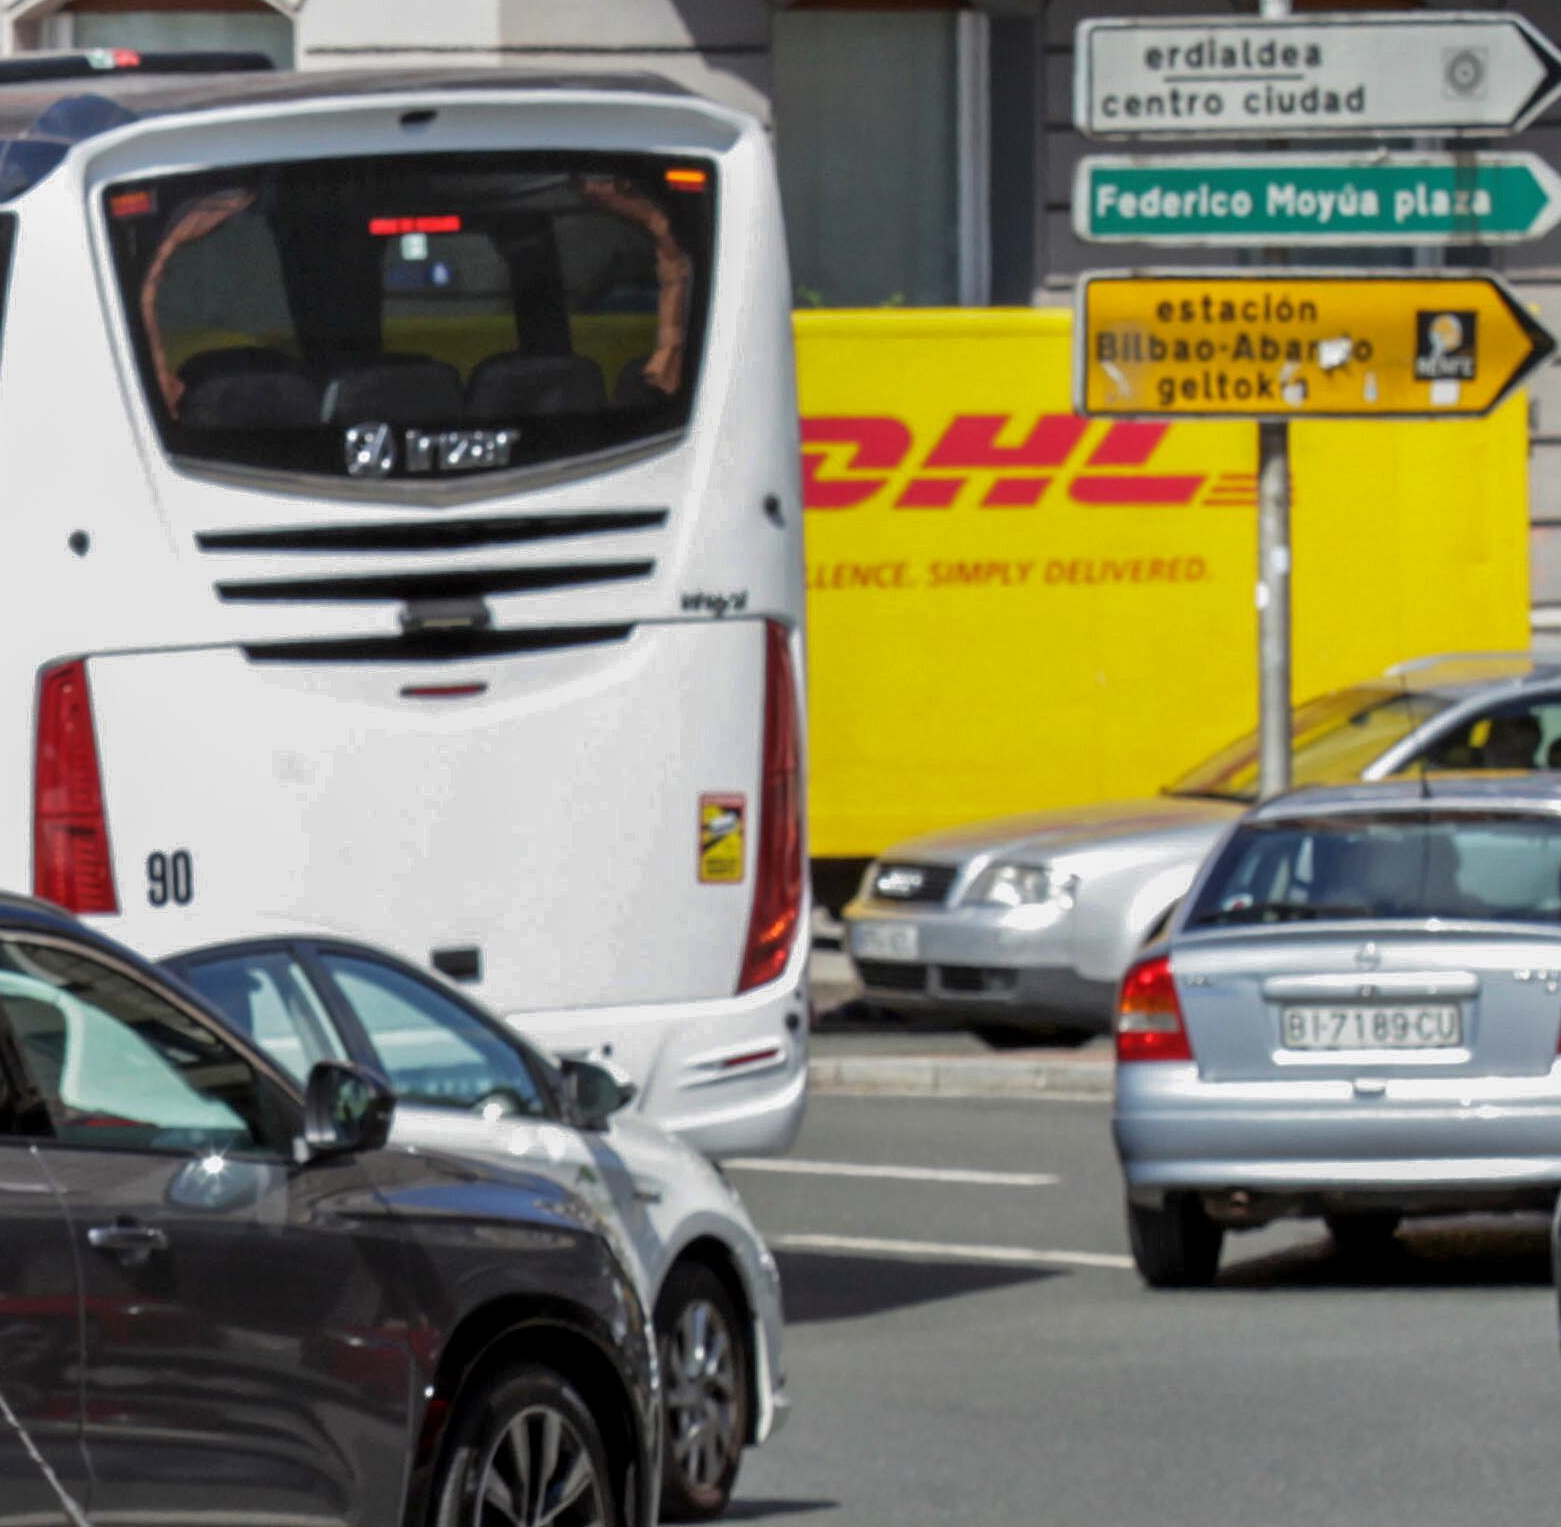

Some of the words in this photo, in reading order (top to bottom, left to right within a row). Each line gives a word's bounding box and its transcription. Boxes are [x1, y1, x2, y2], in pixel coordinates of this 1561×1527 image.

[1143, 37, 1322, 70] erdialdea
[1100, 89, 1224, 118] centro
[1244, 85, 1367, 116] ciudad
[1096, 184, 1253, 219] Federico
[1266, 183, 1380, 224] Moyúa
[1393, 184, 1491, 224] plaza
[1156, 293, 1318, 323] estación
[1096, 332, 1373, 363] Bilbao-Abao
[800, 413, 1207, 509] DHL
[928, 559, 1034, 588] SIMPLY
[146, 849, 194, 909] 90
